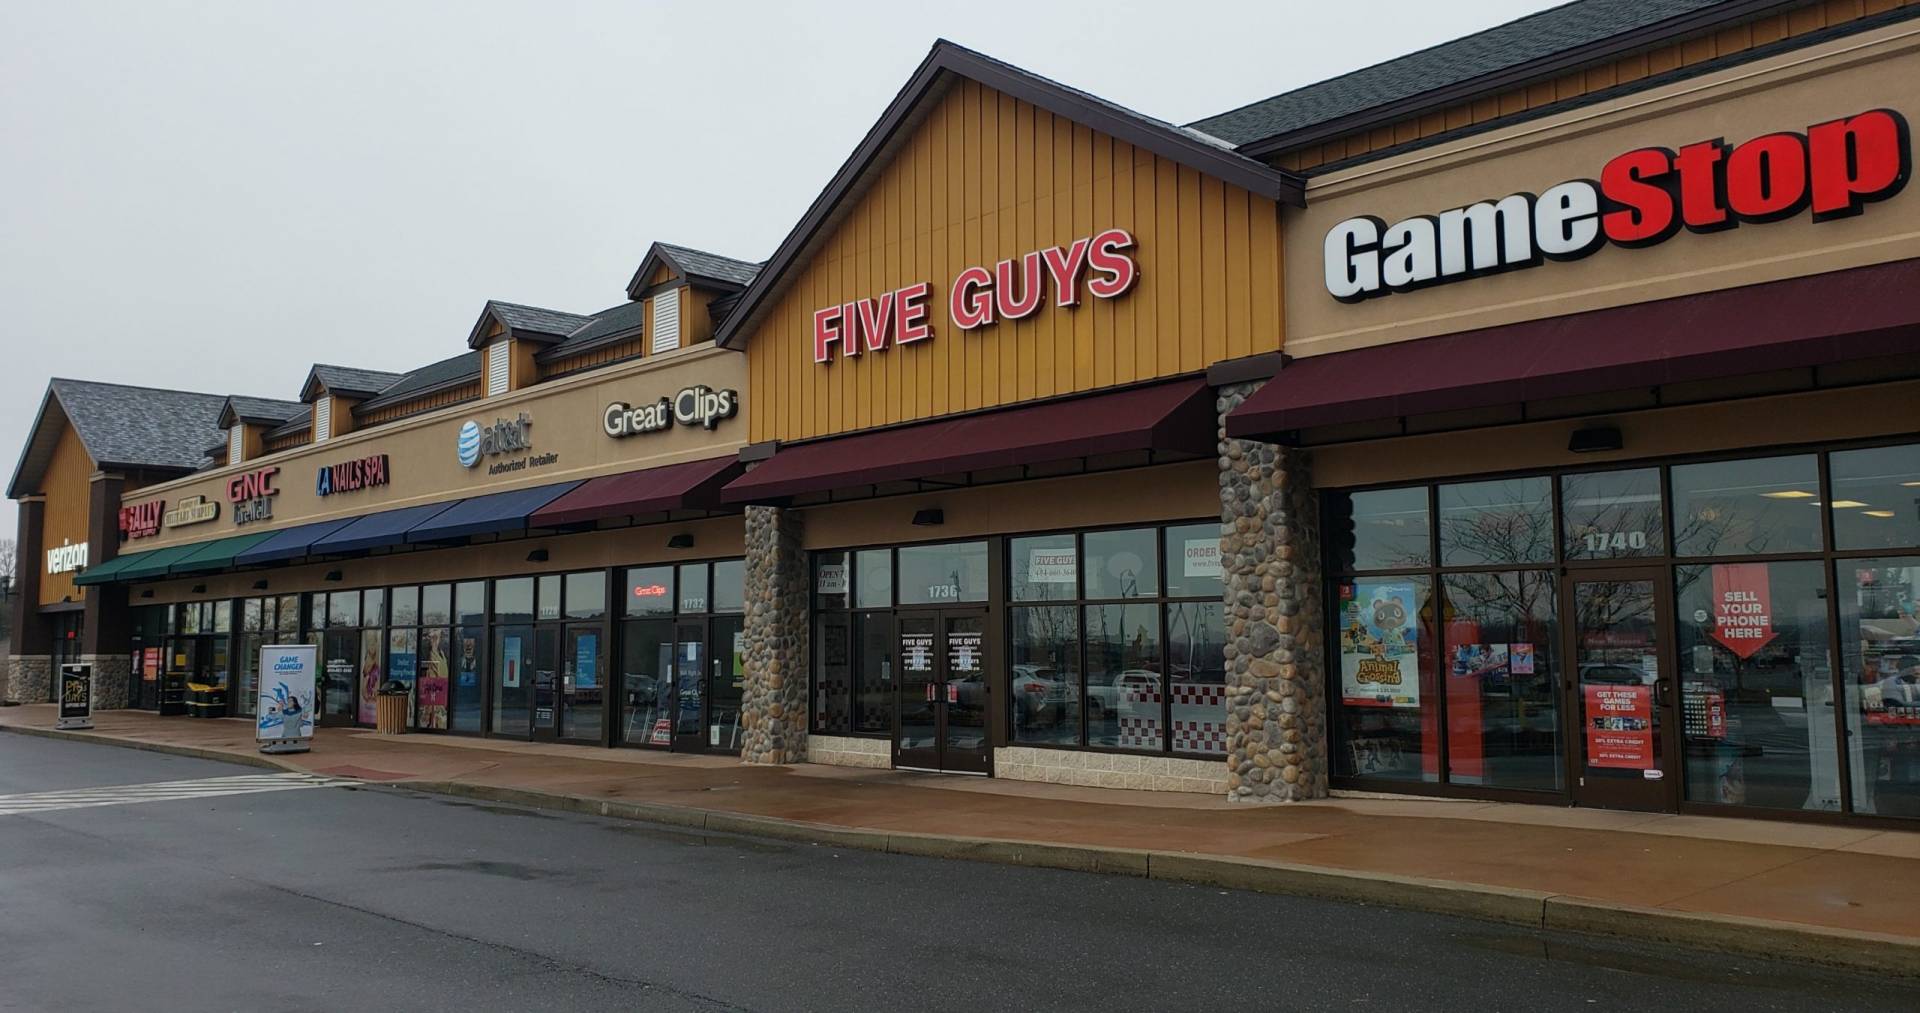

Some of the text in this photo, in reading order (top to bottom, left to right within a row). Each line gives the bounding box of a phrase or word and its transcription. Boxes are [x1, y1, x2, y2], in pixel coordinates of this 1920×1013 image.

[1324, 109, 1910, 302] GameStop
[814, 229, 1139, 364] FIVE GUYS
[603, 386, 734, 437] Great Clips
[482, 412, 533, 456] at&t
[488, 453, 559, 475] Authorized Retailer
[316, 455, 385, 496] LA NAILS SPA
[226, 466, 277, 502] GNC
[1583, 531, 1646, 551] 1740
[48, 538, 88, 574] verizon
[1187, 548, 1217, 558] ORDER
[1035, 555, 1074, 565] FIVE GUY
[819, 570, 838, 578] OPEN
[634, 585, 667, 598] Great Clips
[928, 585, 958, 598] 1736
[1724, 592, 1758, 602] SELL
[684, 598, 704, 608] 1732
[1721, 603, 1762, 614] YOUR
[1717, 616, 1768, 626] PHONE
[1724, 628, 1763, 638] HERE
[273, 663, 304, 671] CHANGER
[1360, 660, 1399, 672] Animal
[1358, 671, 1402, 684] Crossing
